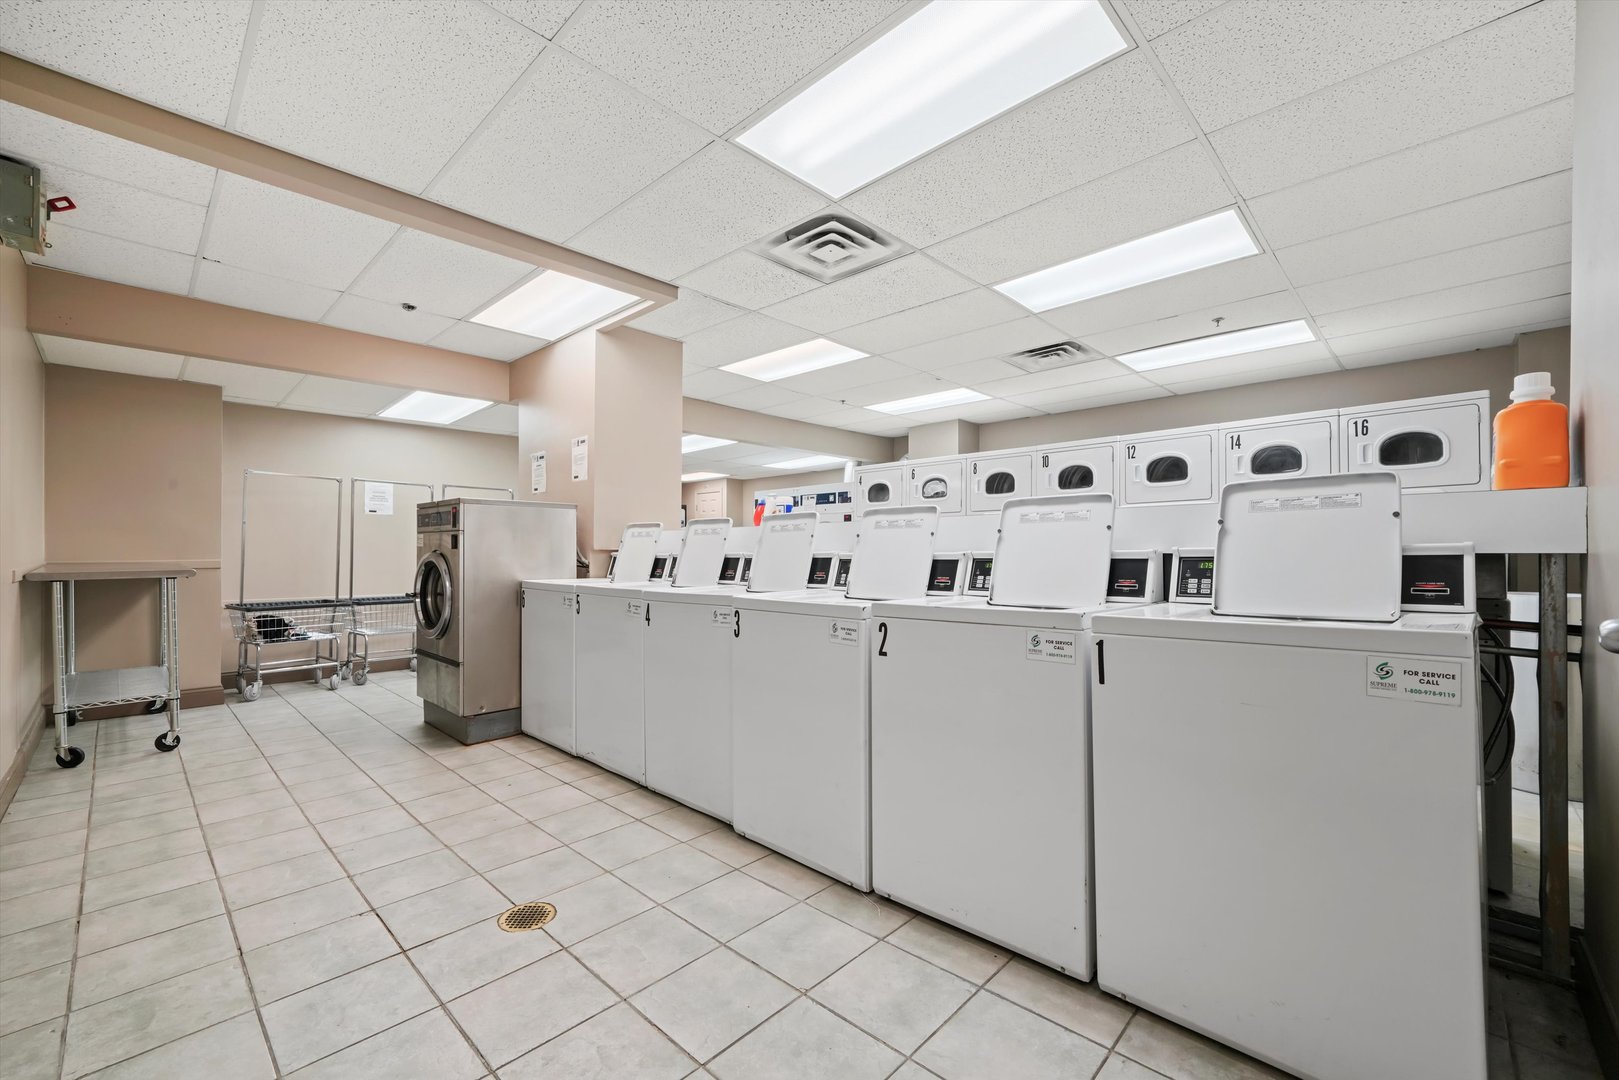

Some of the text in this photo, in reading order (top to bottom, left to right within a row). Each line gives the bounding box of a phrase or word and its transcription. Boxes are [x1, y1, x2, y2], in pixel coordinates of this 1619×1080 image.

[1352, 419, 1368, 437] 16
[1230, 434, 1241, 450] 14
[1127, 445, 1136, 459] 12
[973, 462, 977, 475] 8
[1041, 455, 1049, 468] 10
[911, 468, 916, 480] 6
[576, 594, 580, 615] 5
[645, 602, 651, 627] 4
[733, 609, 740, 638] 3
[878, 622, 888, 657] 2
[1096, 639, 1105, 685] 1
[1403, 669, 1456, 681] FOR SERVICE
[1418, 678, 1440, 686] CALL
[1369, 680, 1398, 689] SUPREME
